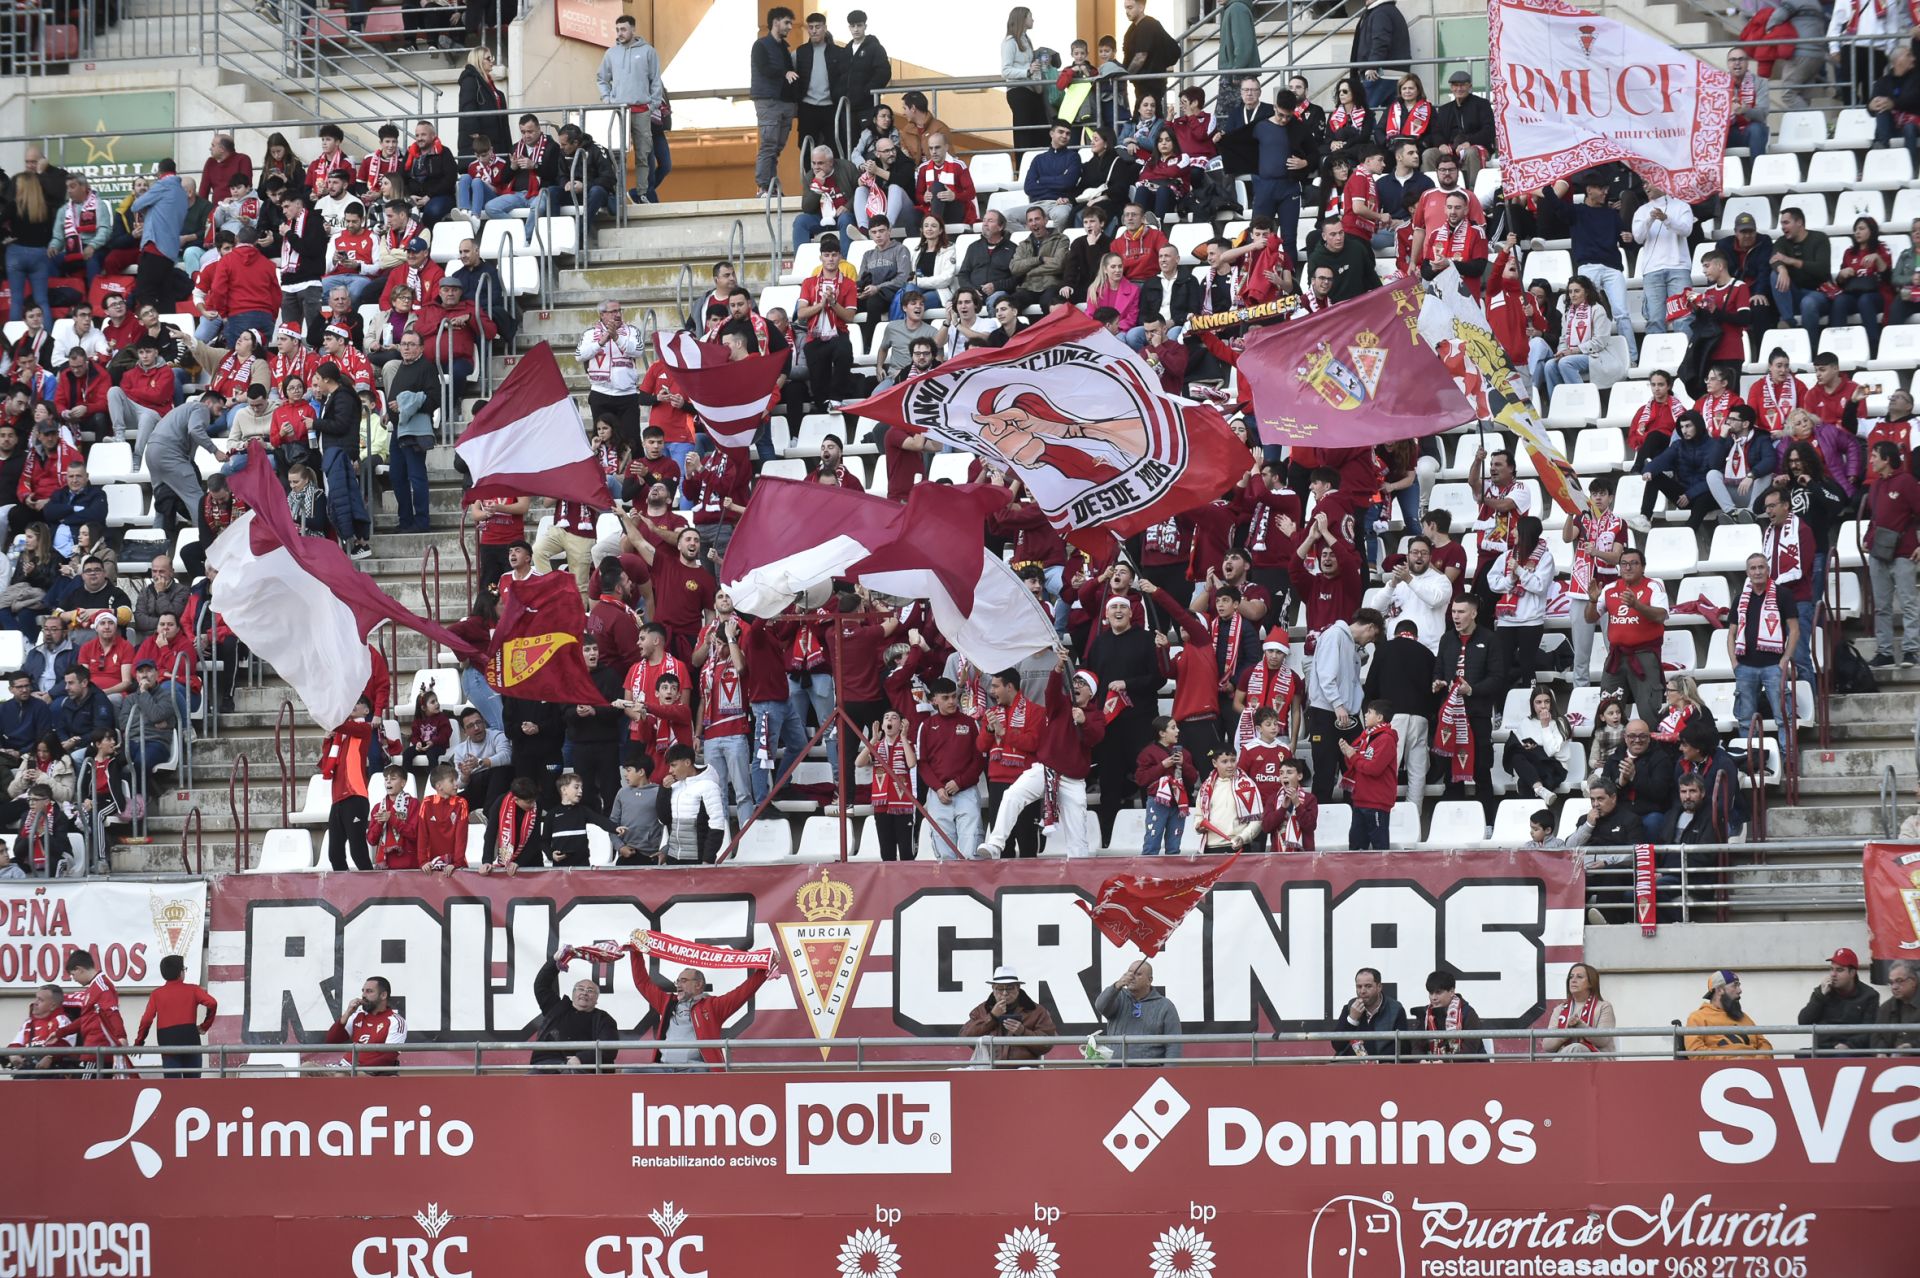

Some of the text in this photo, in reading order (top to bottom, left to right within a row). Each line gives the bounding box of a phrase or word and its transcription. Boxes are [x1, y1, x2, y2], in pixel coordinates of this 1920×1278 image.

[1506, 63, 1687, 119] RMUCF
[1071, 478, 1141, 525] DESDE
[1255, 773, 1281, 782] fibran
[1636, 869, 1652, 896] ALMA
[647, 936, 667, 951] REAL
[667, 943, 700, 959] MURCIA
[700, 950, 723, 963] CLUB
[723, 953, 735, 963] DE
[798, 927, 852, 938] MURCIA
[793, 948, 822, 1016] CLUB
[827, 943, 859, 1016] FUTBOL
[175, 1104, 474, 1158] PrimaFrio
[632, 1092, 778, 1147] Inmo
[798, 1093, 931, 1166] polt
[632, 1155, 778, 1167] Rentabilizando activos
[876, 1203, 902, 1227] bp
[1034, 1201, 1060, 1226] bp
[1190, 1200, 1217, 1225] bp
[1412, 1193, 1817, 1249] Puerta de Murcia
[351, 1235, 473, 1278] CRC
[584, 1234, 708, 1278] CRC
[1664, 1256, 1708, 1278] 968
[1711, 1256, 1738, 1278] 27
[1742, 1256, 1770, 1278] 73
[1774, 1256, 1808, 1278] 05
